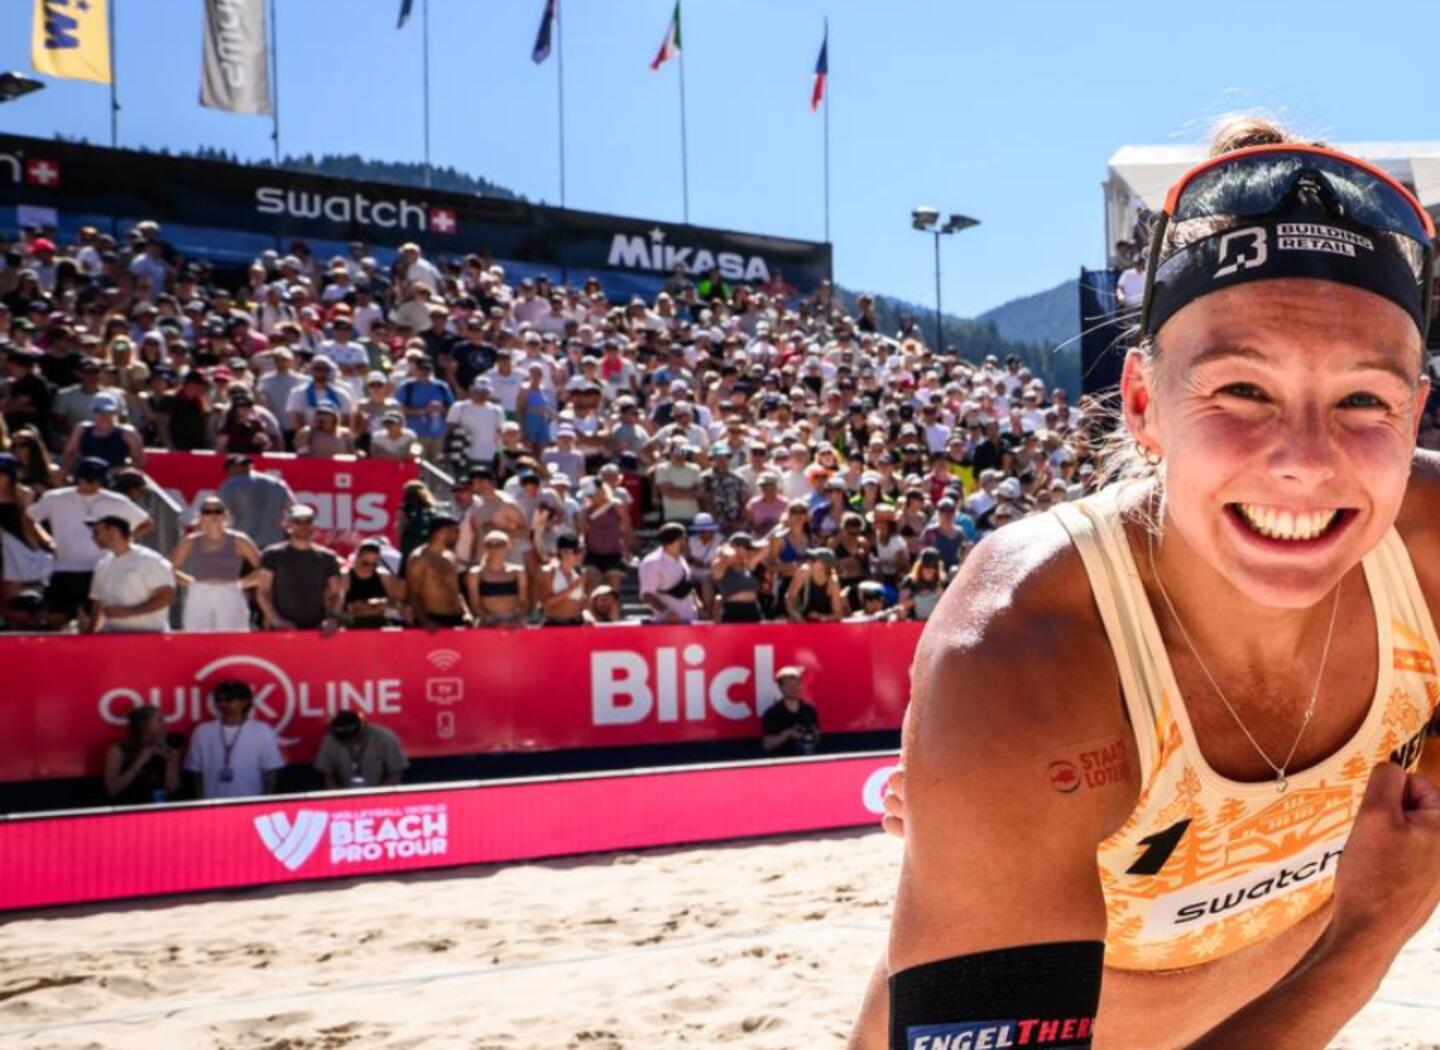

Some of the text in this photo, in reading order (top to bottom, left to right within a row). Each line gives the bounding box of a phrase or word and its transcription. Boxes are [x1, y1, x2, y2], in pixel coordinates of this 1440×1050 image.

[255, 186, 426, 232] swatch
[1282, 239, 1350, 254] RETAIL
[330, 812, 447, 846] BEACH
[330, 837, 447, 865] PRO TOUR
[1125, 818, 1192, 875] 1
